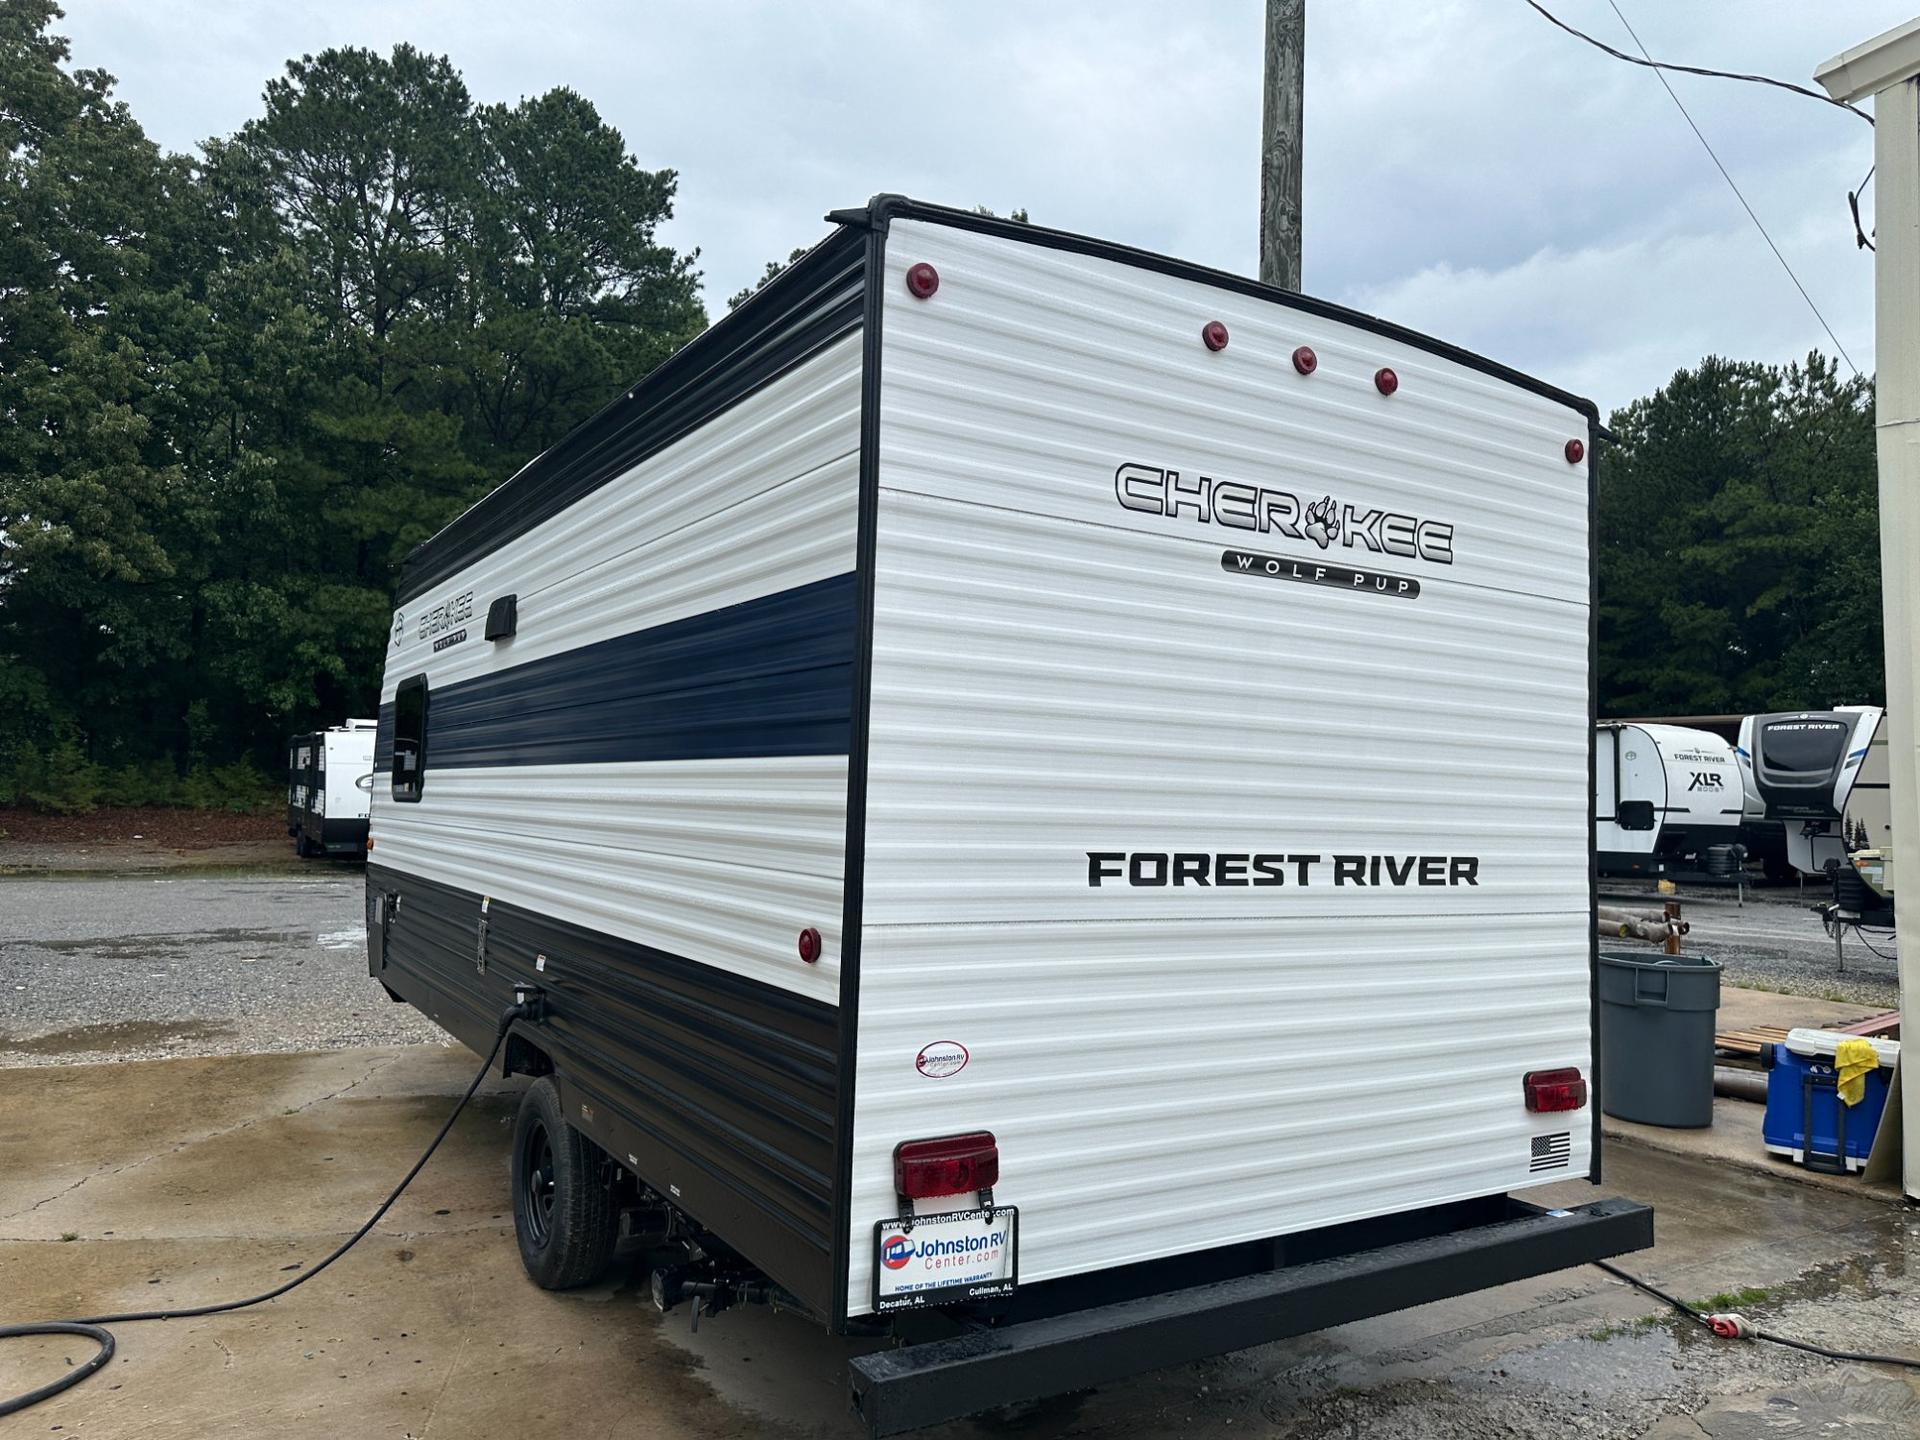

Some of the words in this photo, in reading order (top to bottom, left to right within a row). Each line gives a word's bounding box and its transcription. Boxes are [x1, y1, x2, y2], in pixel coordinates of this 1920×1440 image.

[1236, 555, 1327, 581] WOLF
[1353, 573, 1409, 593] PUP
[1674, 754, 1702, 762] FOREST
[1704, 755, 1726, 763] RIVER
[1688, 771, 1724, 791] XLR
[1086, 851, 1321, 887] FOREST
[1332, 854, 1480, 887] RIVER
[916, 1235, 987, 1258] Johnston
[990, 1230, 1007, 1247] RV
[924, 1249, 999, 1270] Center.com
[895, 1284, 914, 1292] HOME
[925, 1281, 936, 1289] THE
[937, 1278, 963, 1288] LIFETIME
[964, 1272, 993, 1284] WARRANTY
[969, 1285, 1001, 1297] Cullman,
[1003, 1283, 1014, 1291] AL
[879, 1297, 912, 1310] Decatur,
[914, 1295, 926, 1304] AL
